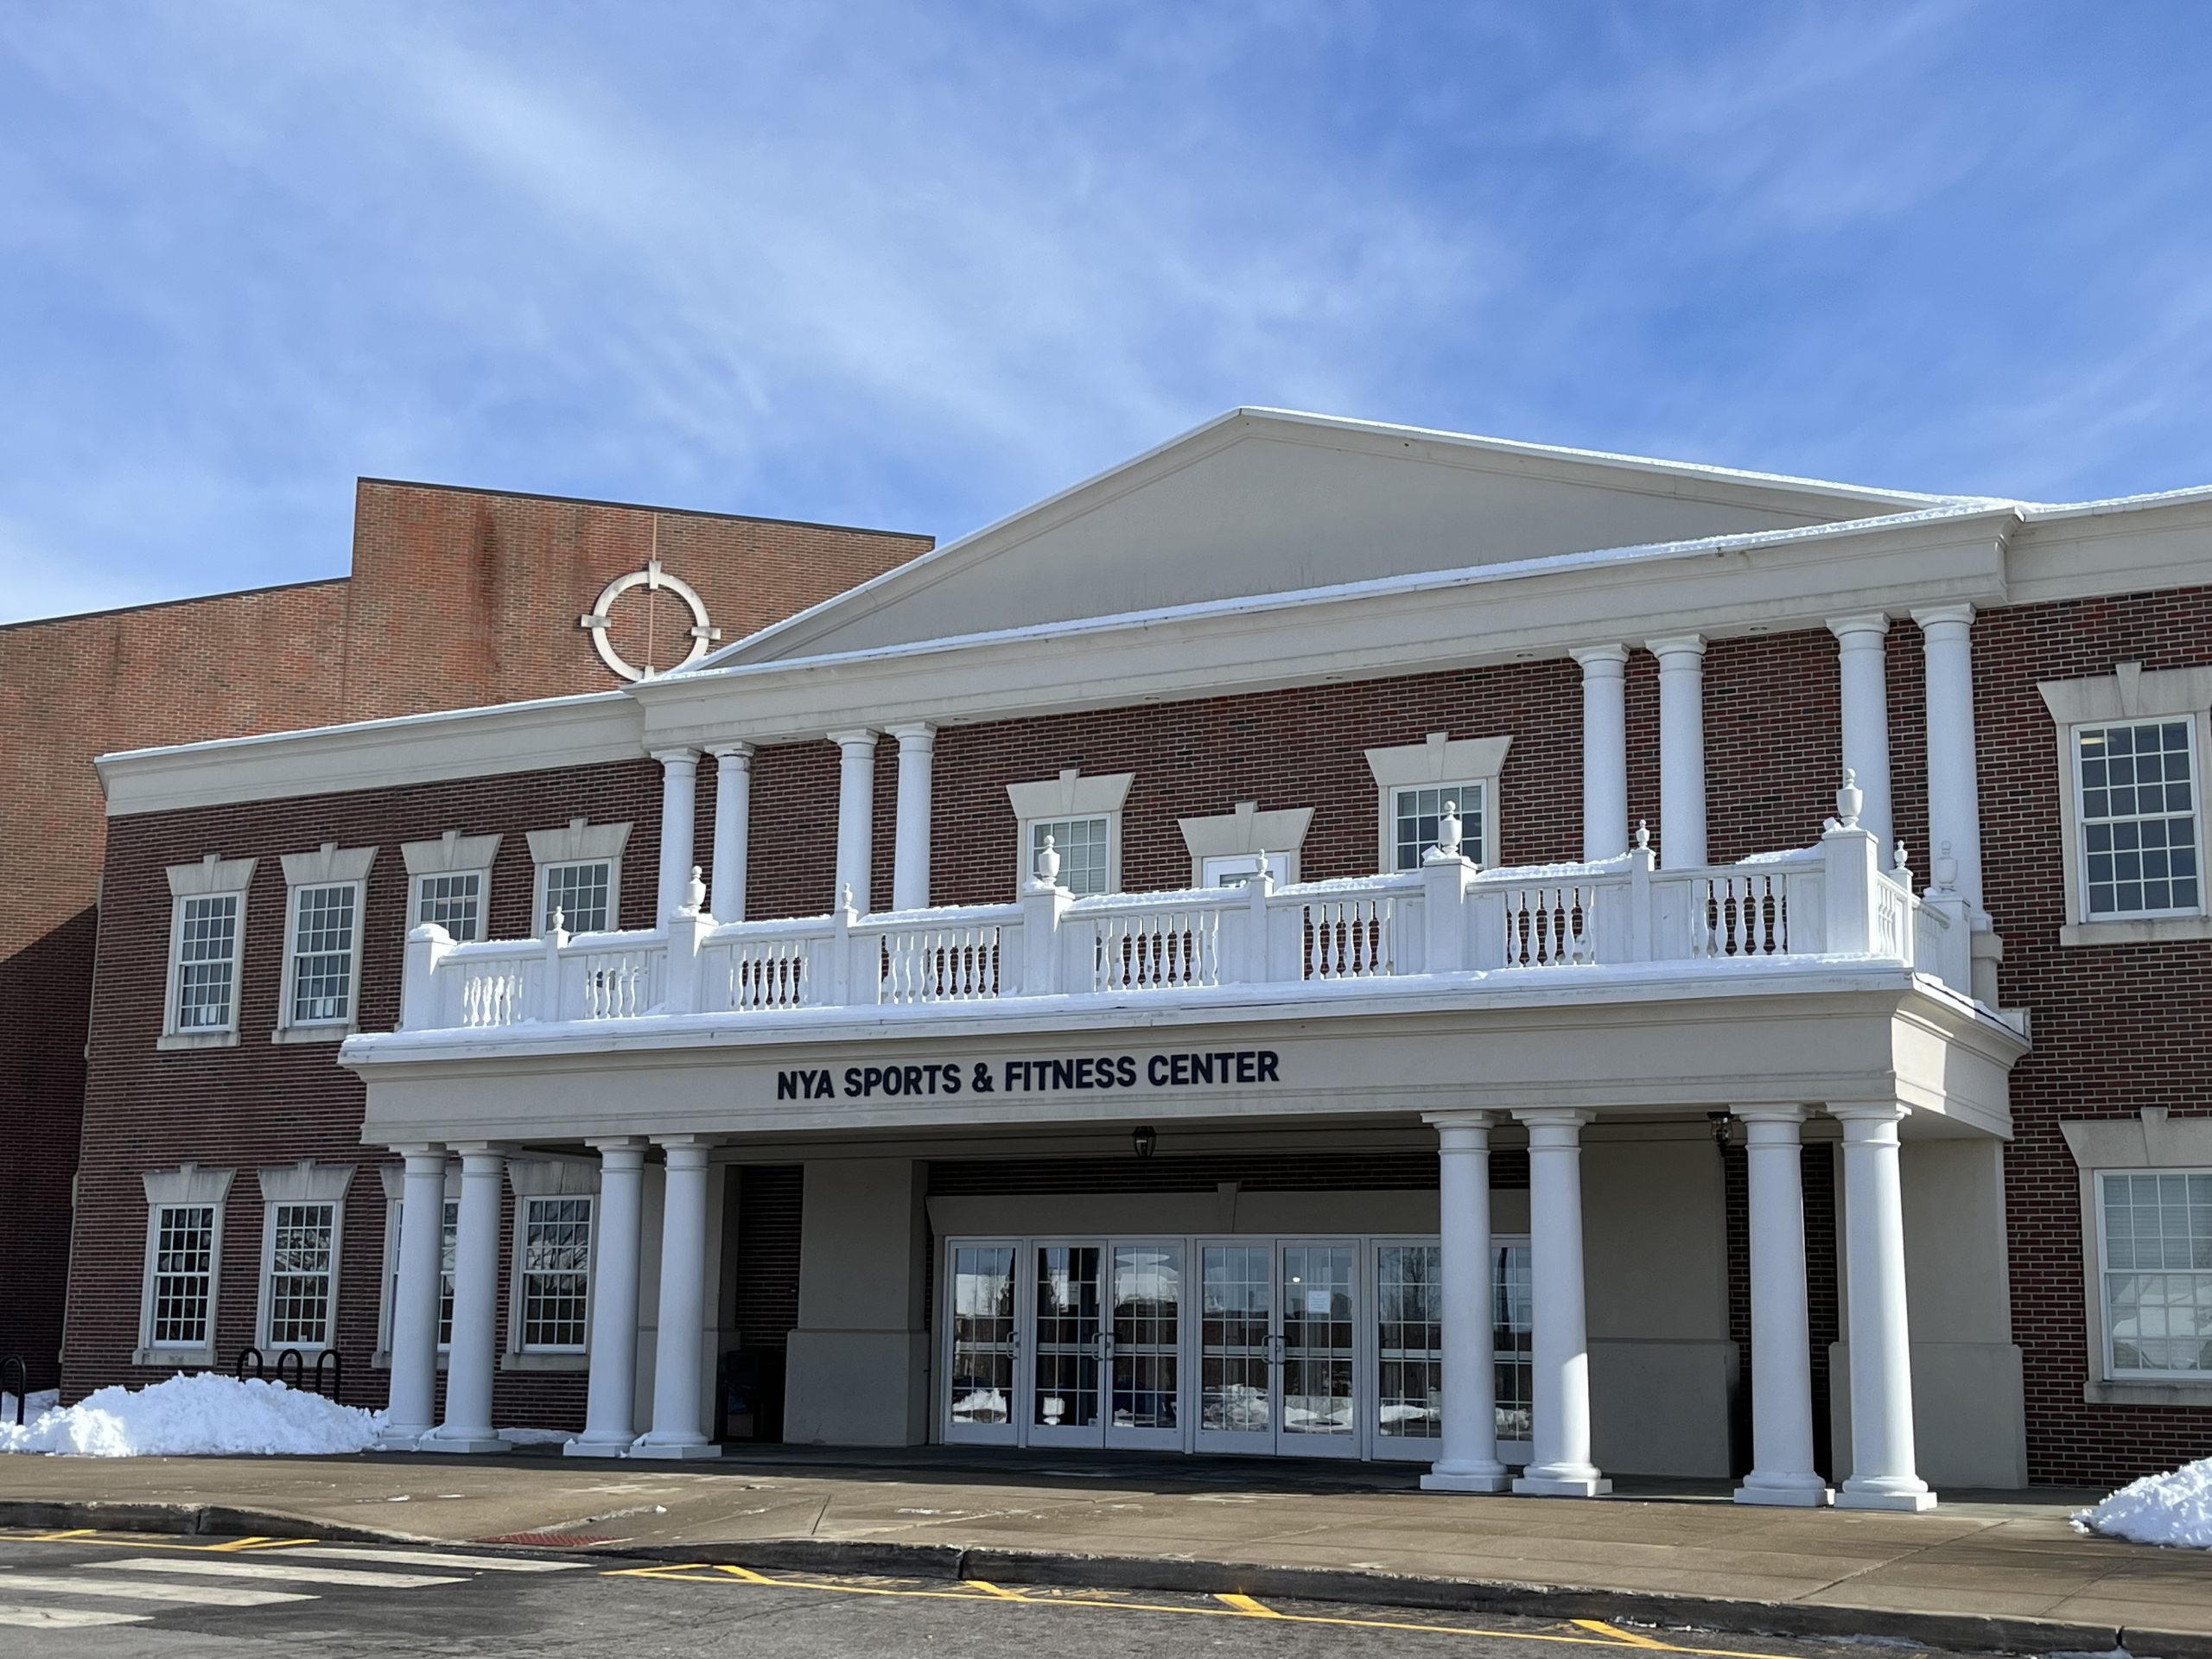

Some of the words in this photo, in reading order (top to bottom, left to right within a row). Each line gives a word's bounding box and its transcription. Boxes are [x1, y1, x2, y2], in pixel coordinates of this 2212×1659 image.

[778, 1069, 836, 1101] NYA
[843, 1062, 962, 1097] SPORTS
[971, 1062, 995, 1093] &
[1004, 1055, 1137, 1092] FITNESS
[1147, 1050, 1280, 1087] CENTER
